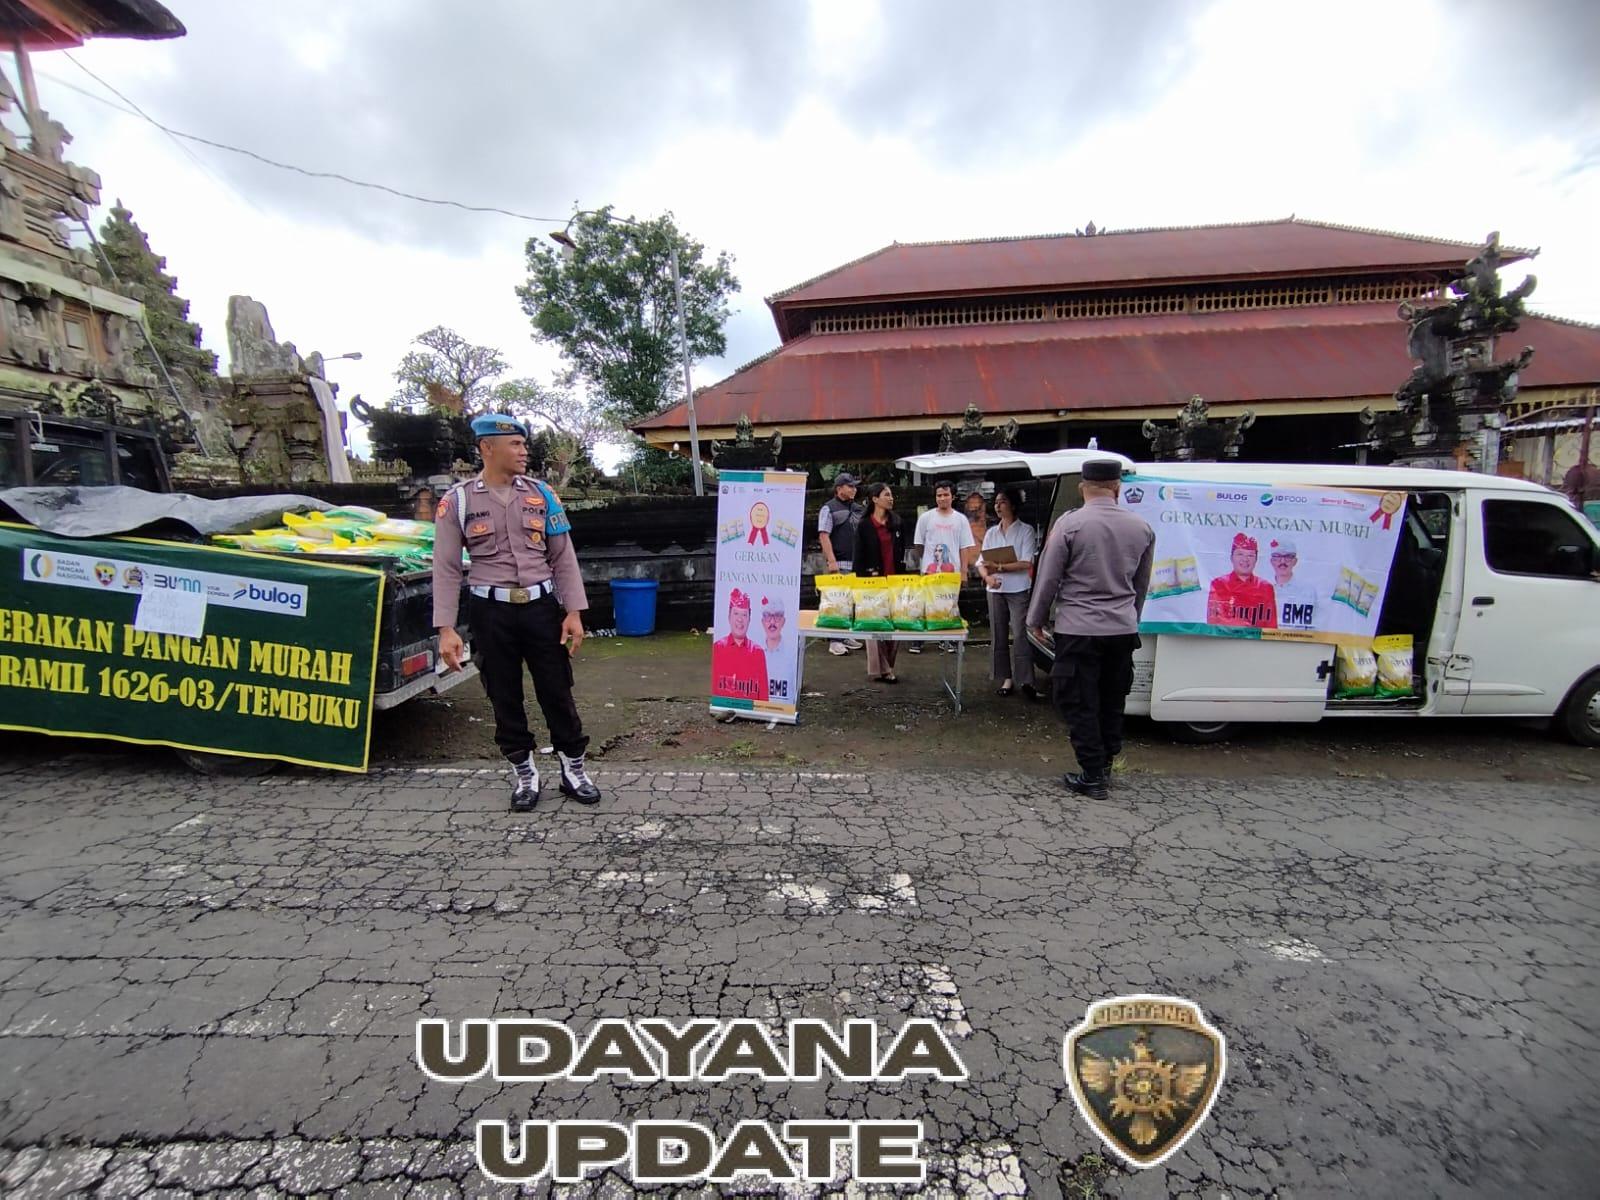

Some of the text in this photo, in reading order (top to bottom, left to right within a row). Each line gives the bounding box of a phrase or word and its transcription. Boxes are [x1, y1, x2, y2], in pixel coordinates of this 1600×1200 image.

[1216, 492, 1248, 501] BULOG
[1285, 495, 1308, 503] FOOD
[1160, 510, 1370, 539] GERAKAN PANGAN MURAH
[734, 550, 781, 563] GERAKAN
[719, 571, 798, 587] PANGAN MURAH
[249, 584, 301, 609] bulog
[1282, 603, 1314, 624] BMB
[122, 624, 241, 670] PANGAN
[249, 640, 353, 685] MURAH
[0, 655, 361, 729] RAMIL 1626-03/TEMBUKU
[769, 679, 788, 697] BMB
